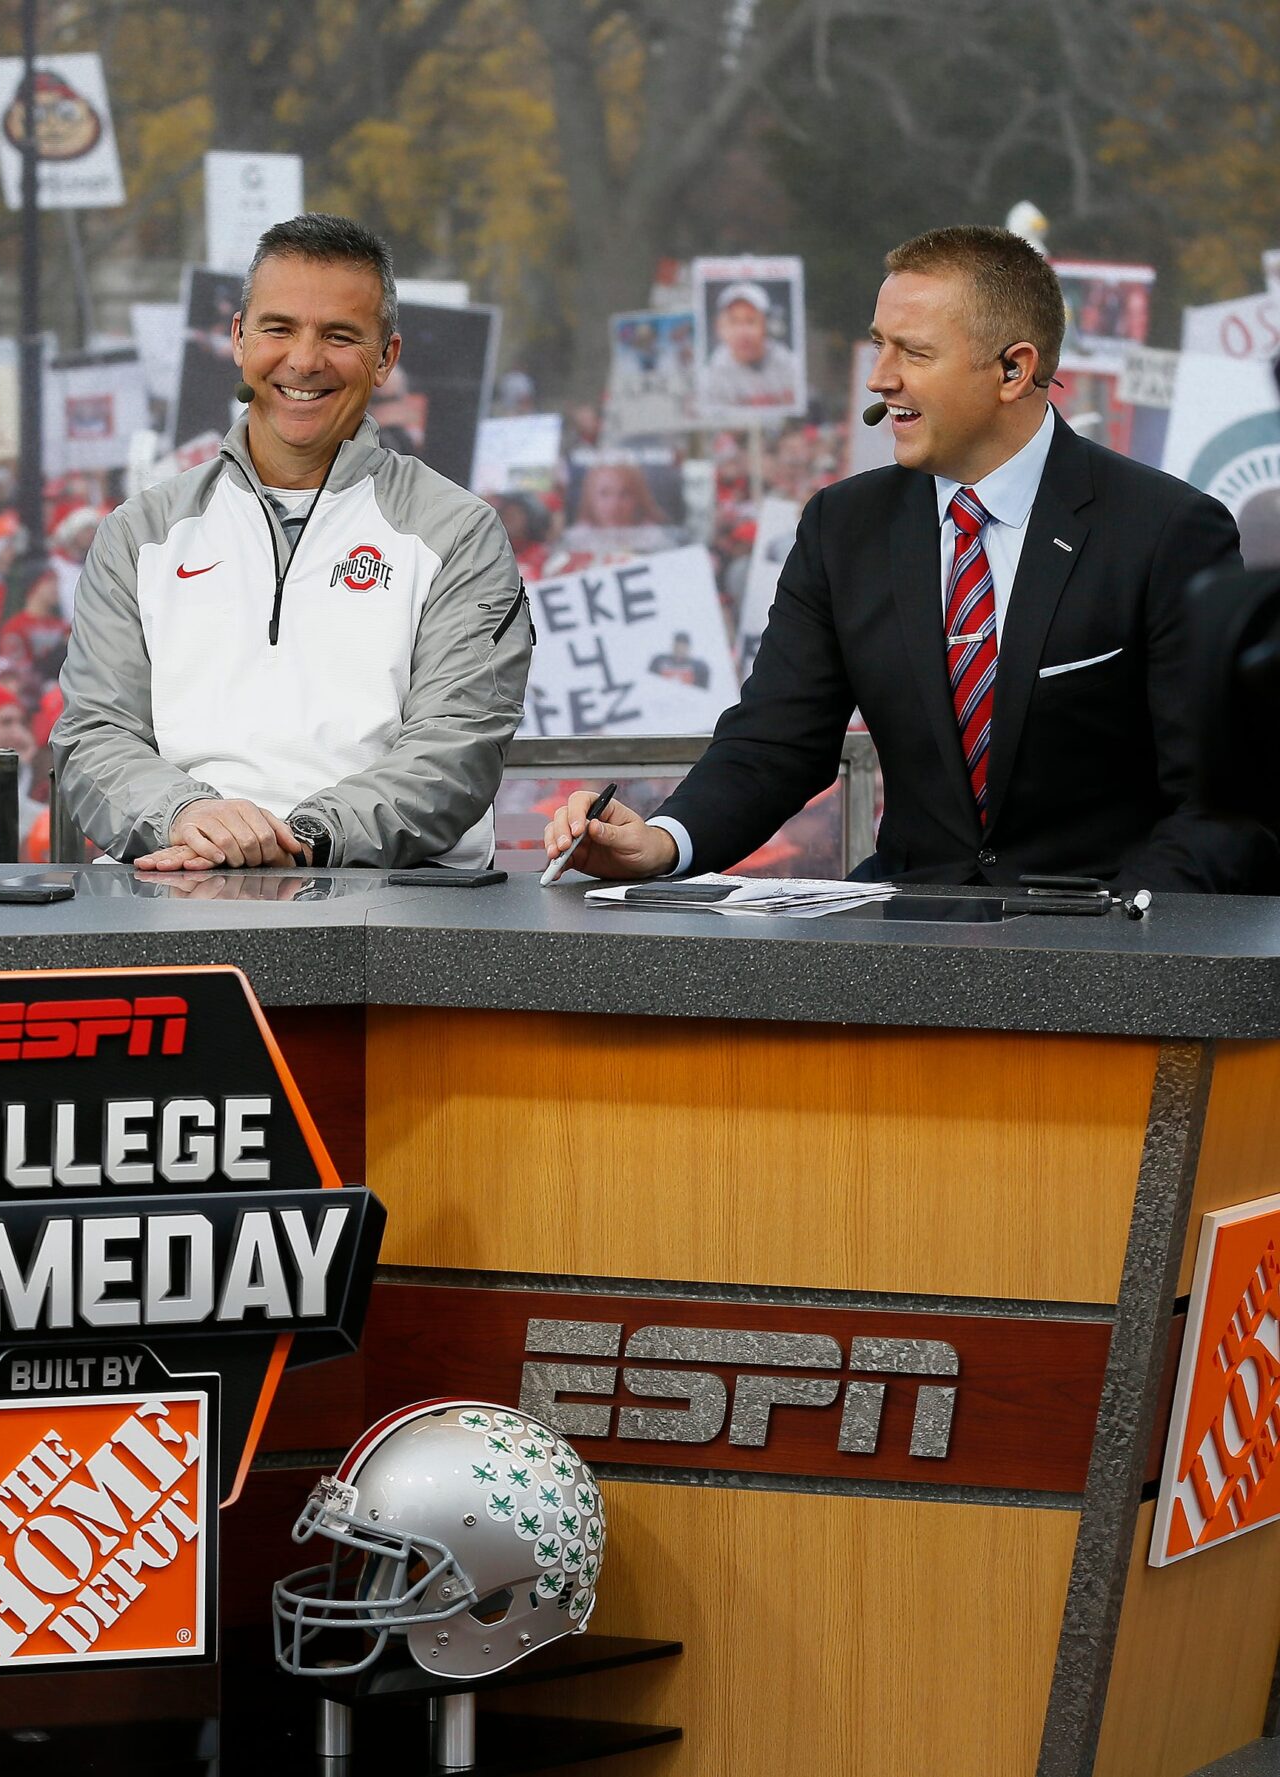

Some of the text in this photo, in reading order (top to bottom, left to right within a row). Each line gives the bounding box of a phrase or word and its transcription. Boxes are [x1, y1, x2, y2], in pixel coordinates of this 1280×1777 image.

[329, 555, 393, 591] OHIO STATE
[567, 634, 614, 694] 4
[11, 1355, 143, 1391] BUILT BY
[519, 1317, 959, 1460] ESPN
[47, 1489, 201, 1656] DEPOT
